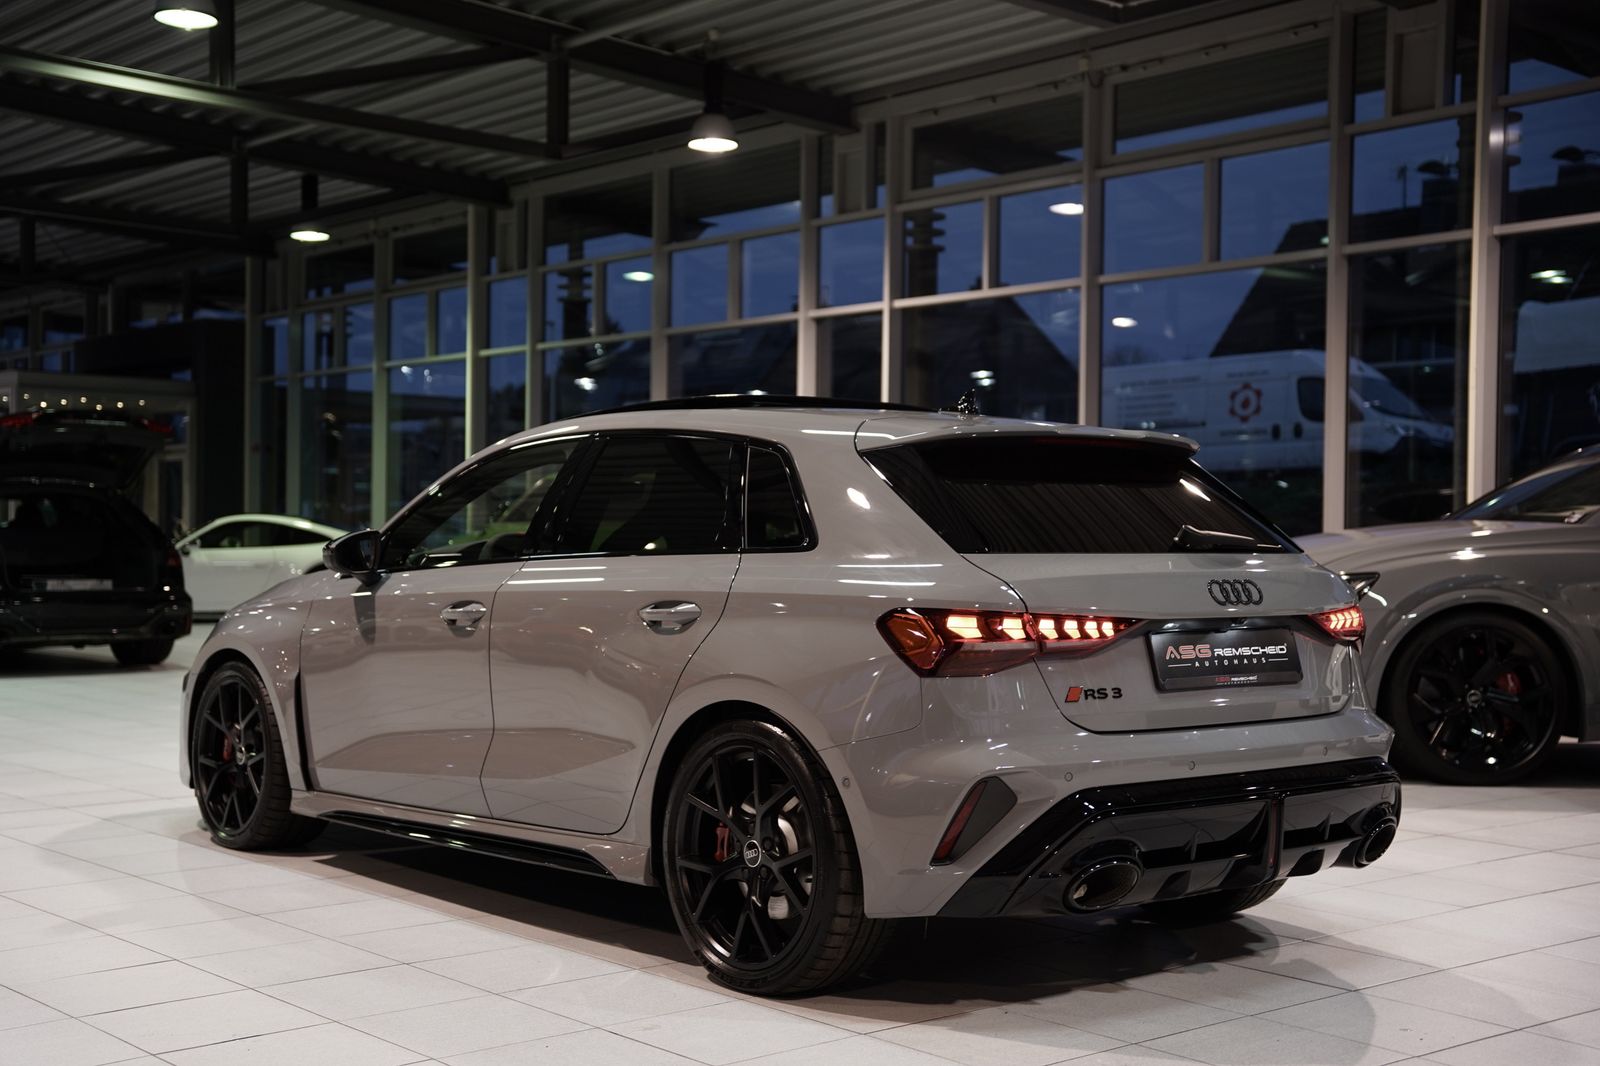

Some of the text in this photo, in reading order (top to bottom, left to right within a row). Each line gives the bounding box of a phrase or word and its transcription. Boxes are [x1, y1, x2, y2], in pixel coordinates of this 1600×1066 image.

[1165, 644, 1287, 660] ASG REMSCHEID
[1194, 657, 1267, 667] AUTOHAUS
[1083, 687, 1123, 701] RS 3
